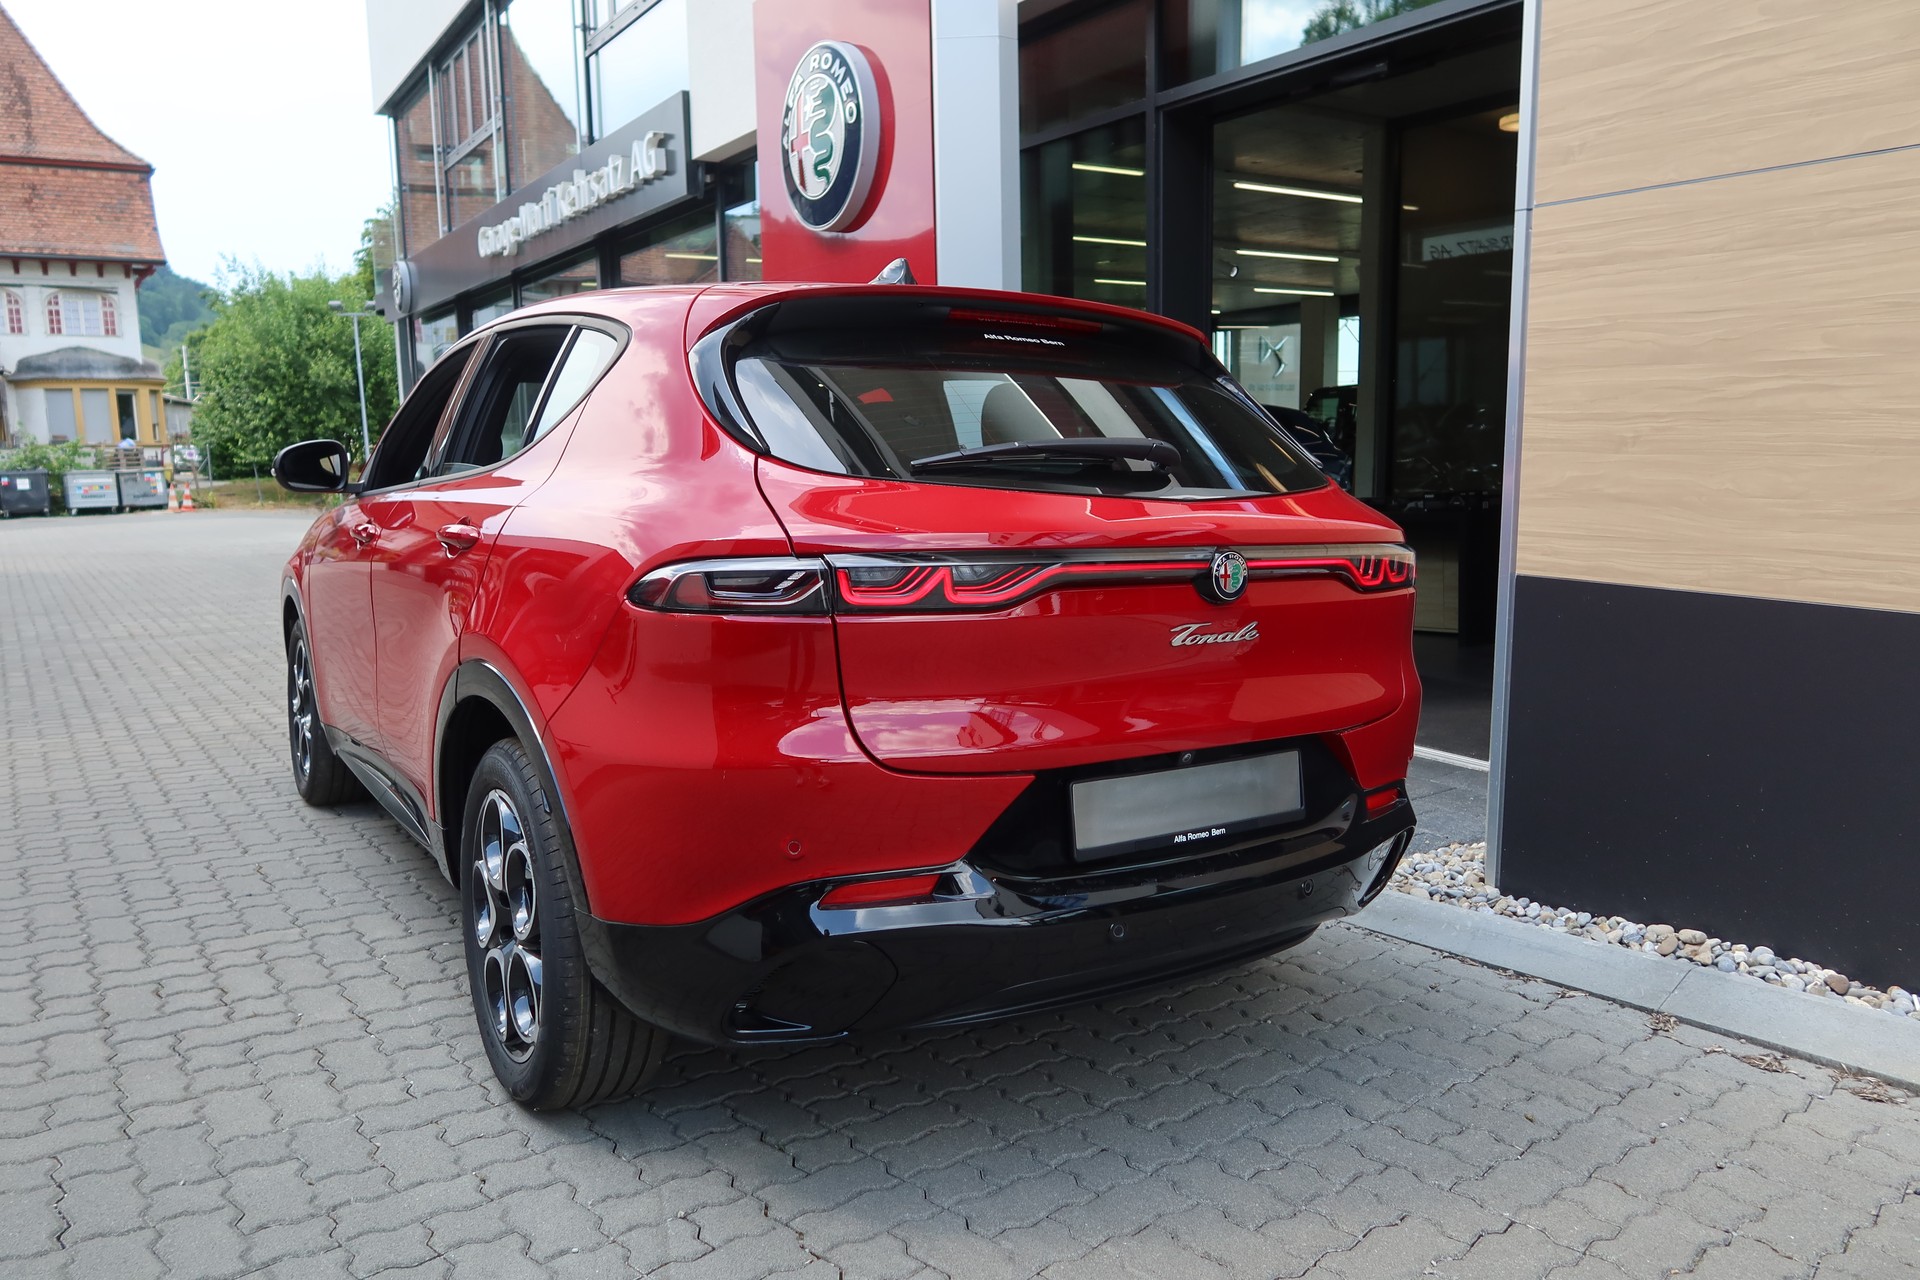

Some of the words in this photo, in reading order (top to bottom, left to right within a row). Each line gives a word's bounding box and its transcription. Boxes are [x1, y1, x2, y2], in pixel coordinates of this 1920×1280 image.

[810, 52, 857, 124] ROMEO
[630, 131, 666, 184] AG
[1004, 335, 1040, 343] Romeo
[1040, 338, 1065, 346] Bern
[1214, 557, 1227, 576] ALFA
[1228, 554, 1248, 576] ROMEO
[1170, 621, 1260, 647] Tonale
[1174, 835, 1187, 843] Alfa
[1187, 831, 1209, 840] Romeo
[1211, 828, 1226, 836] Bern
